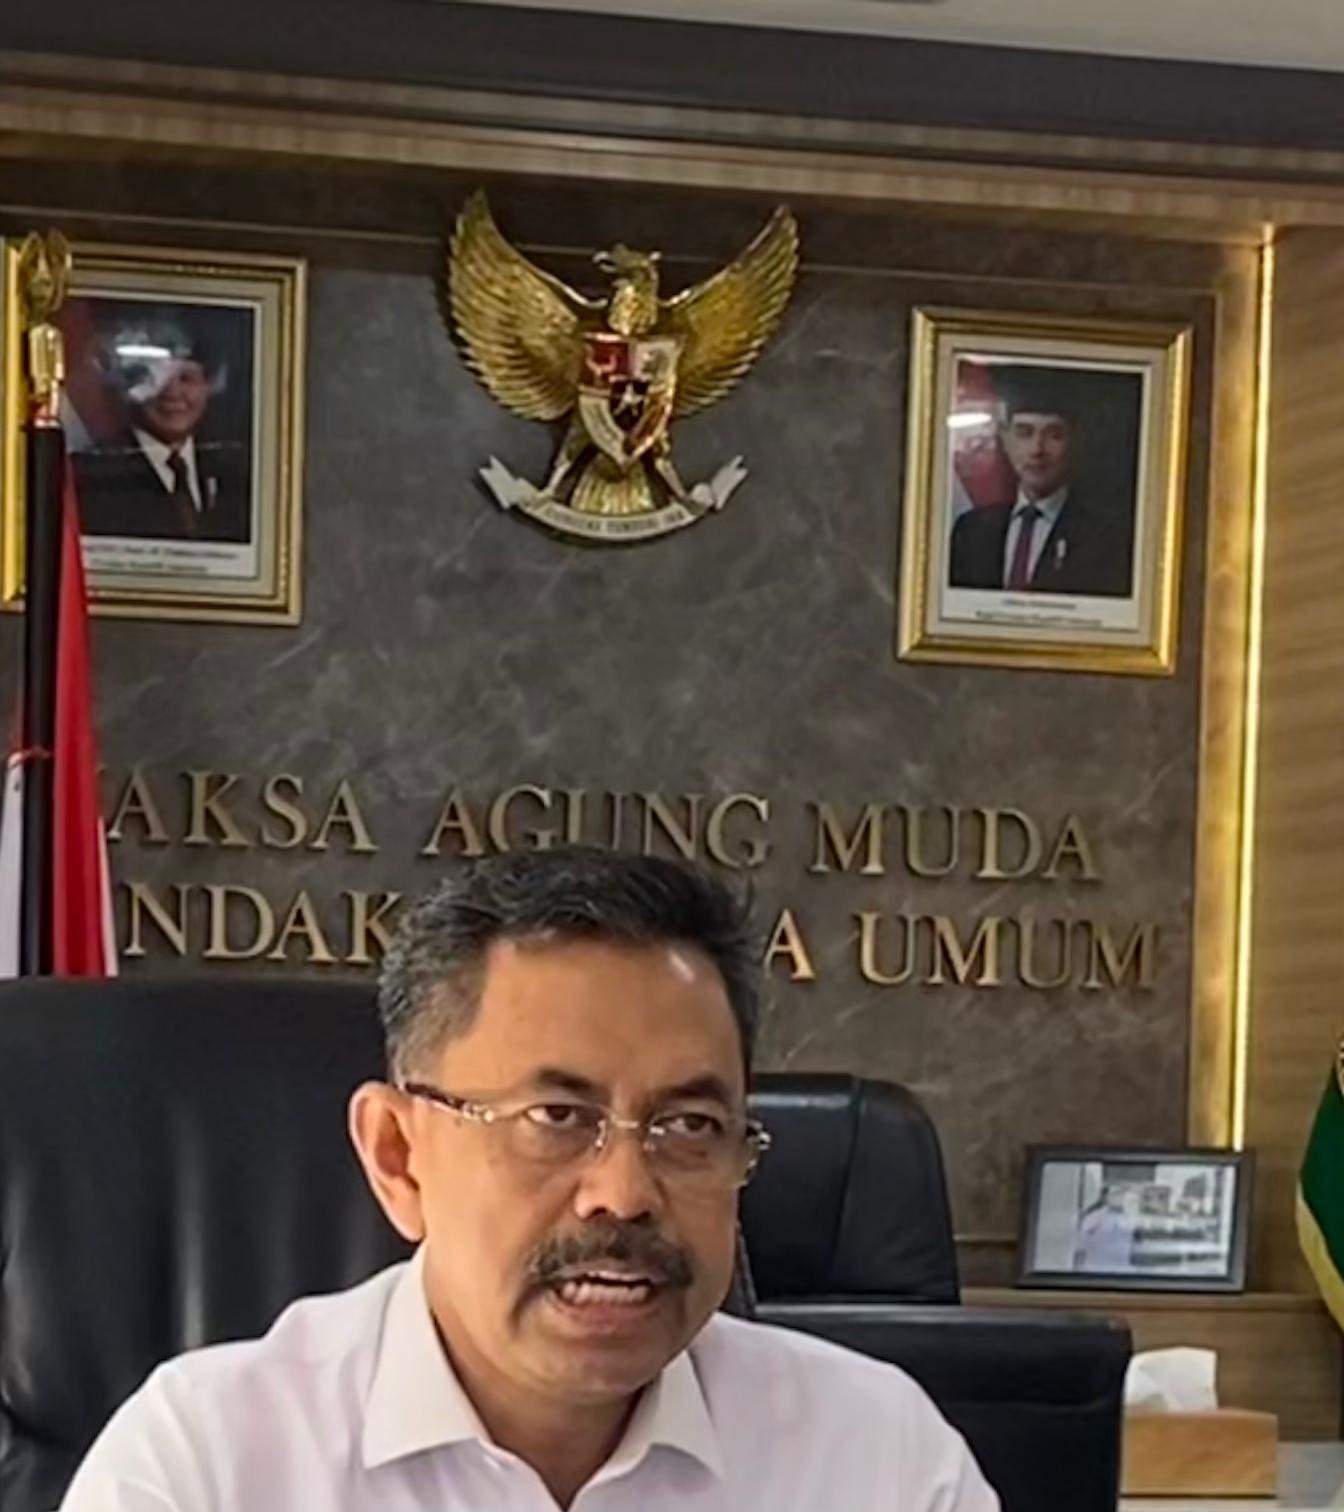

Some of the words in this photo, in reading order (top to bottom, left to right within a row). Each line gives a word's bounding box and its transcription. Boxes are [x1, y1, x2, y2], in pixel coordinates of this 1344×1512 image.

[102, 765, 379, 853] AKSA
[421, 782, 771, 869] AGUNG
[807, 801, 1100, 881] MUDA
[121, 880, 403, 964] NDAK
[856, 911, 1157, 990] UMUM
